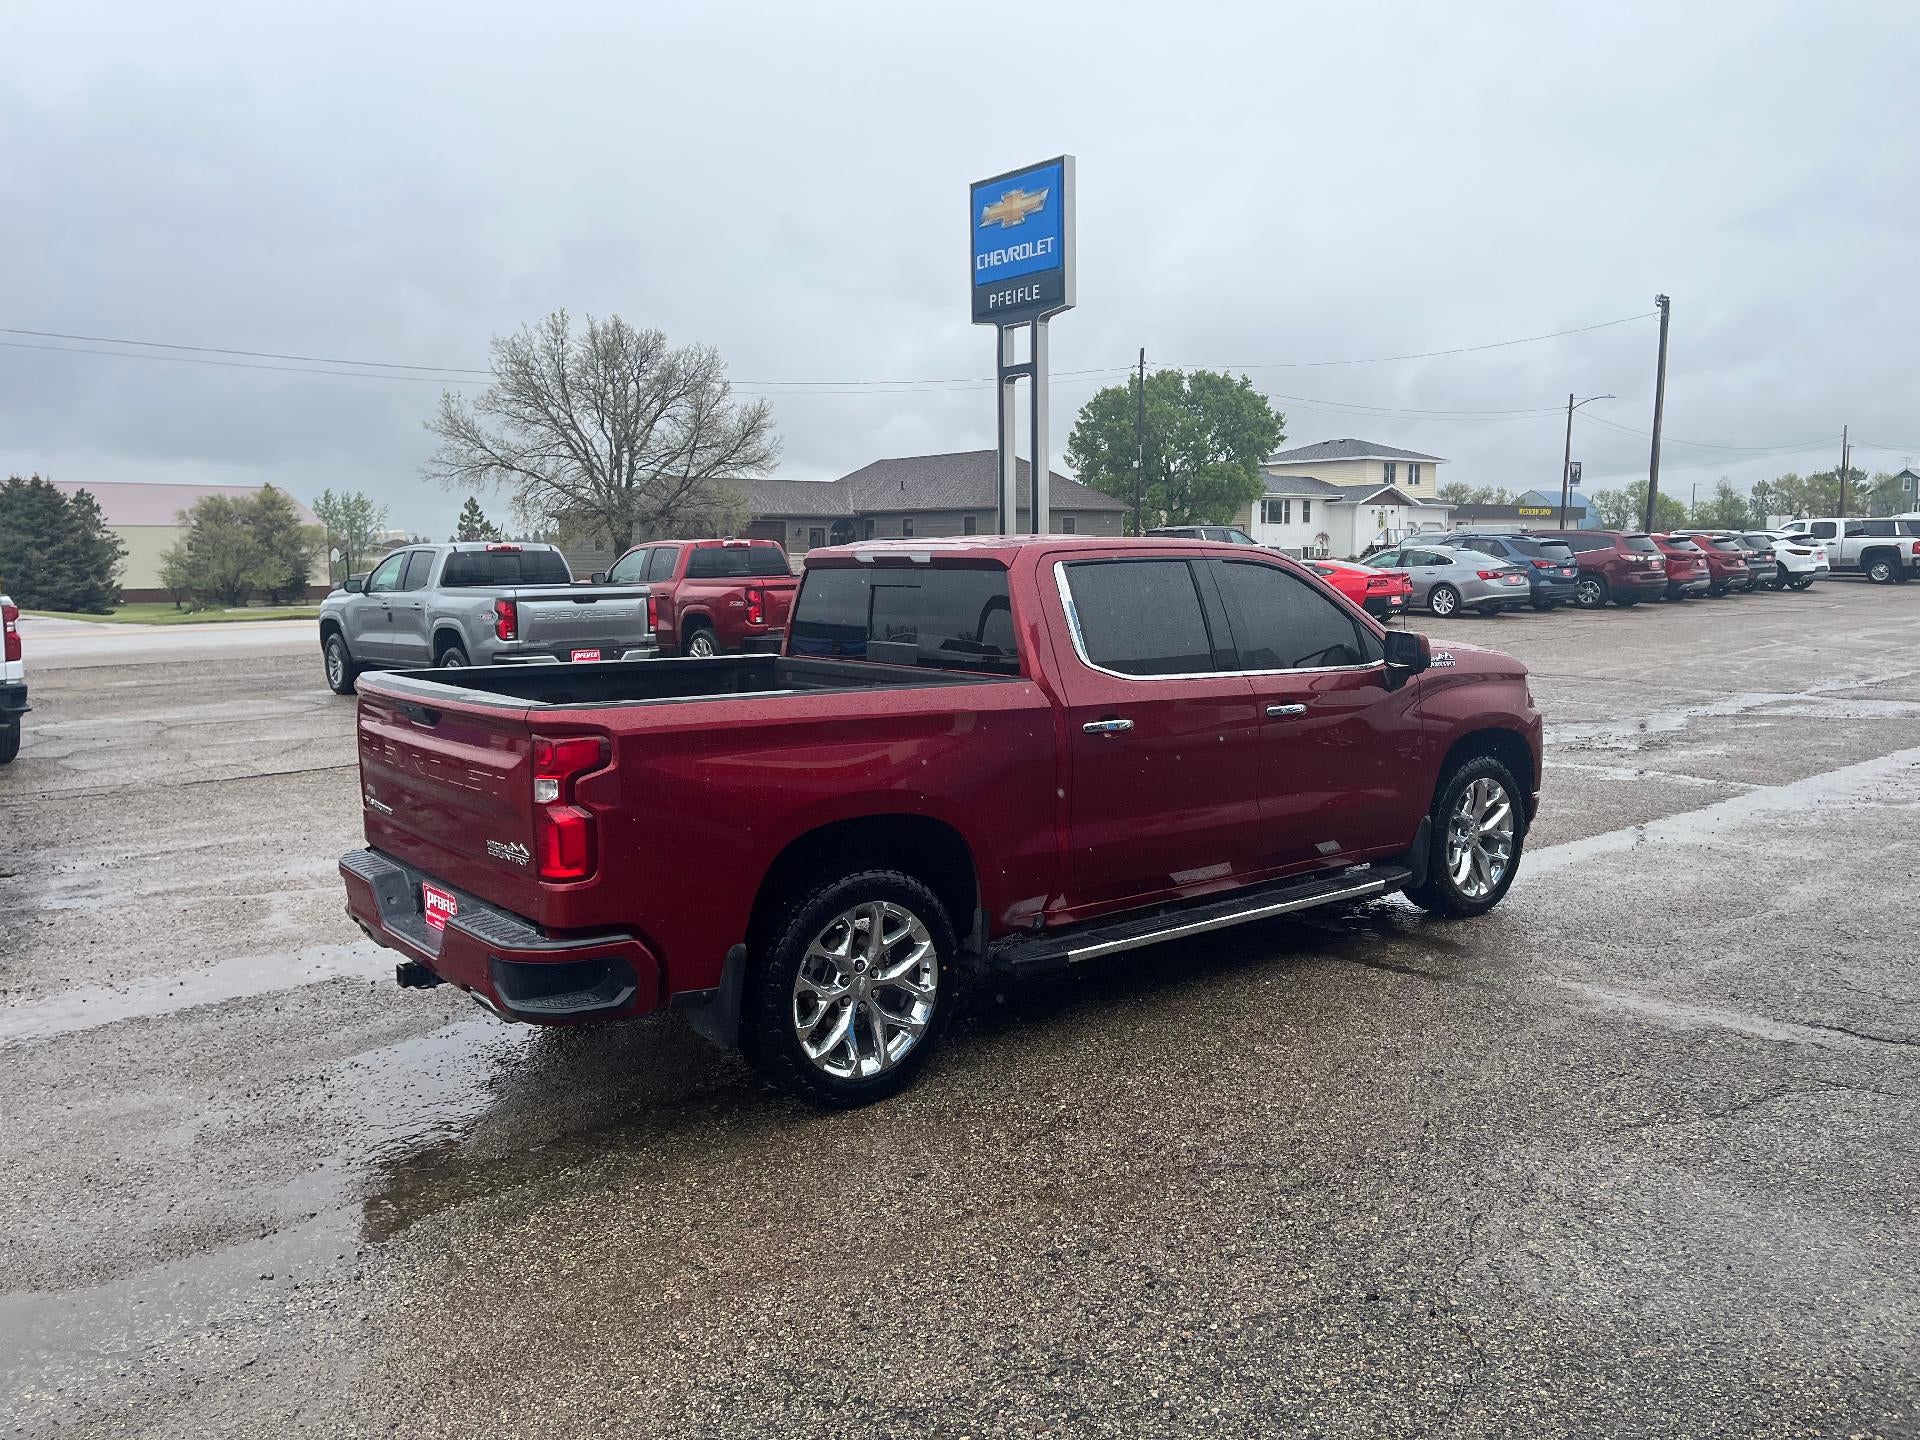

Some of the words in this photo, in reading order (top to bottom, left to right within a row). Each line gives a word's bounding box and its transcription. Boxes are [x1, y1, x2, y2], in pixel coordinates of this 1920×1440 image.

[976, 236, 1055, 270] CHEVROLET
[989, 284, 1040, 309] PFEIFLE
[534, 609, 638, 622] CHEVROLET
[487, 847, 530, 867] COUNTRY
[426, 890, 456, 916] PFEIFLE
